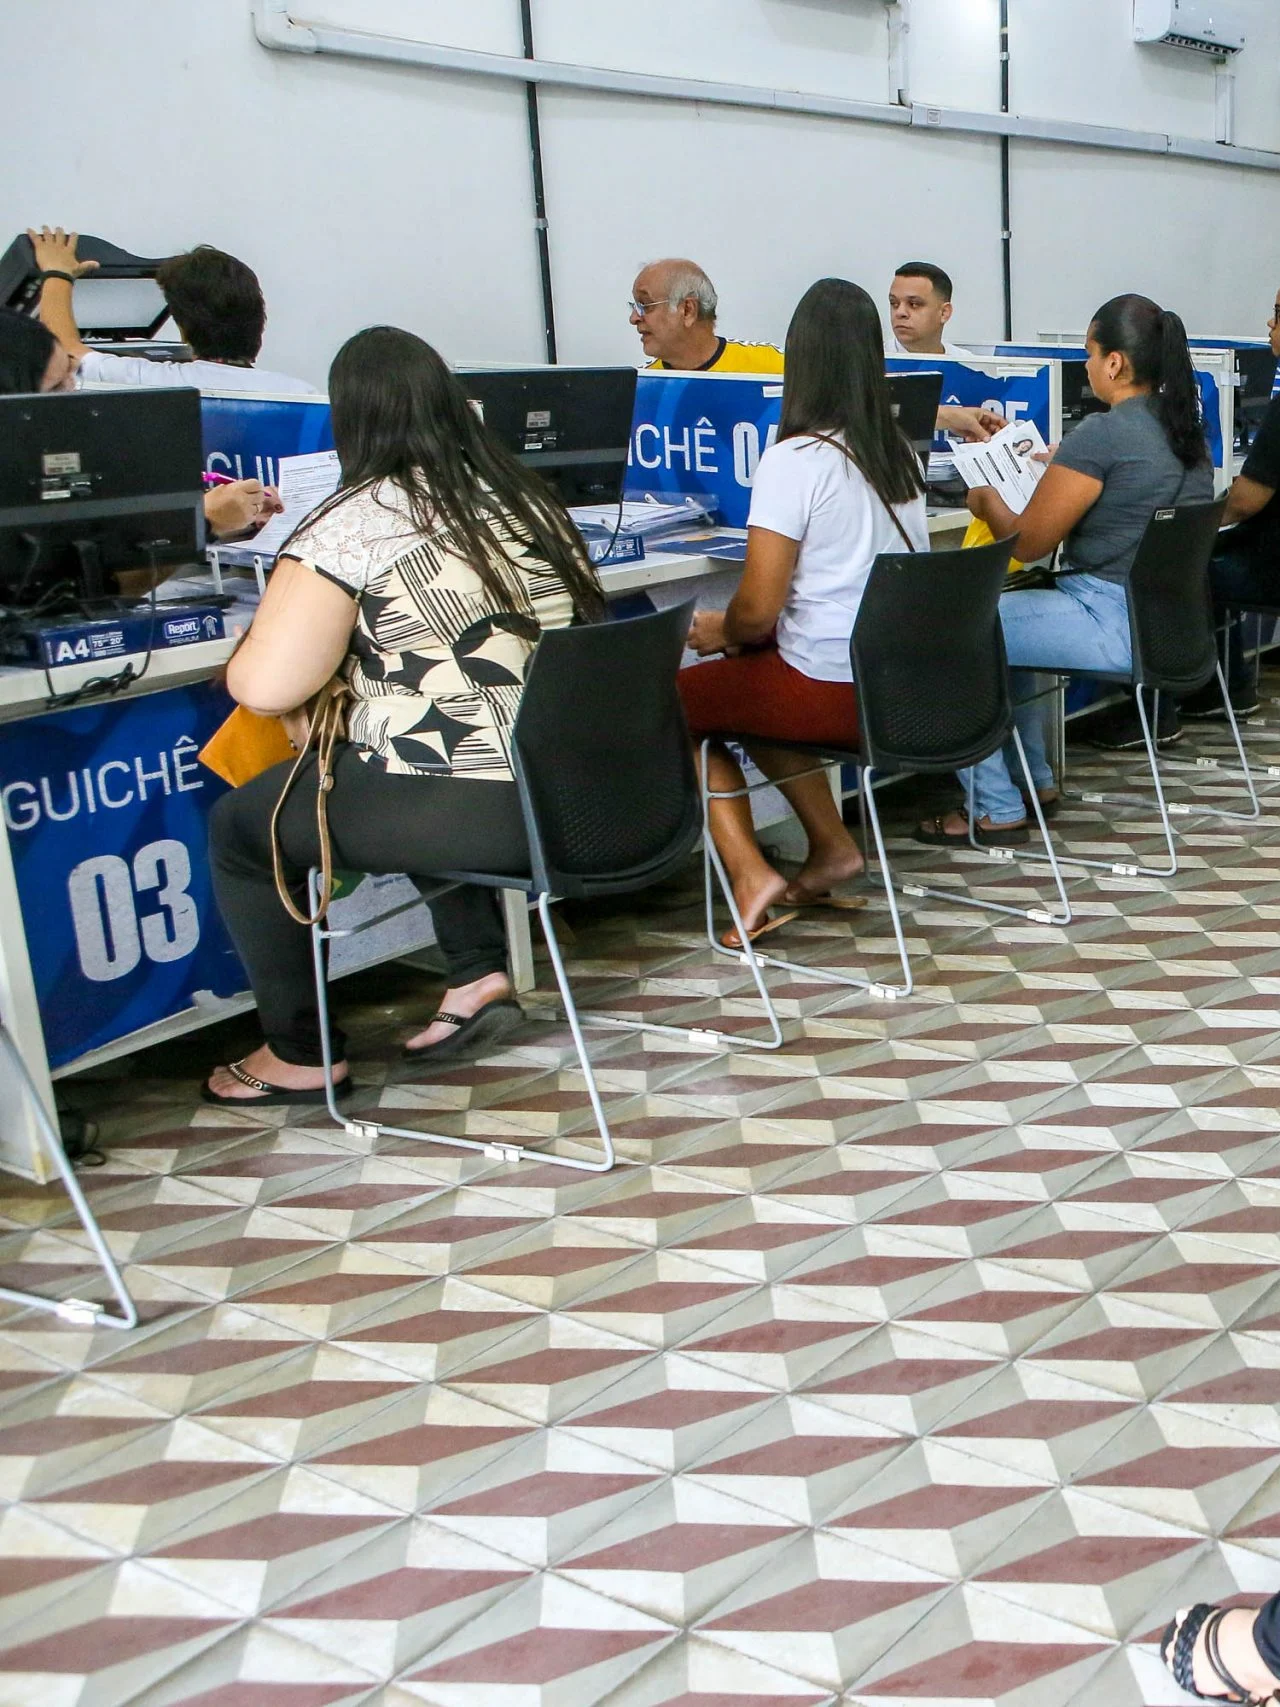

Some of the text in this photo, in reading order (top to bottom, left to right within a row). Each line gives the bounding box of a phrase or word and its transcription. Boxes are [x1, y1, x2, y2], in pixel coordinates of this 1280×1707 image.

[733, 421, 779, 488] 0
[56, 638, 90, 662] A4
[168, 621, 197, 635] Report
[2, 735, 204, 831] GUICHÊ
[68, 839, 200, 982] 03
